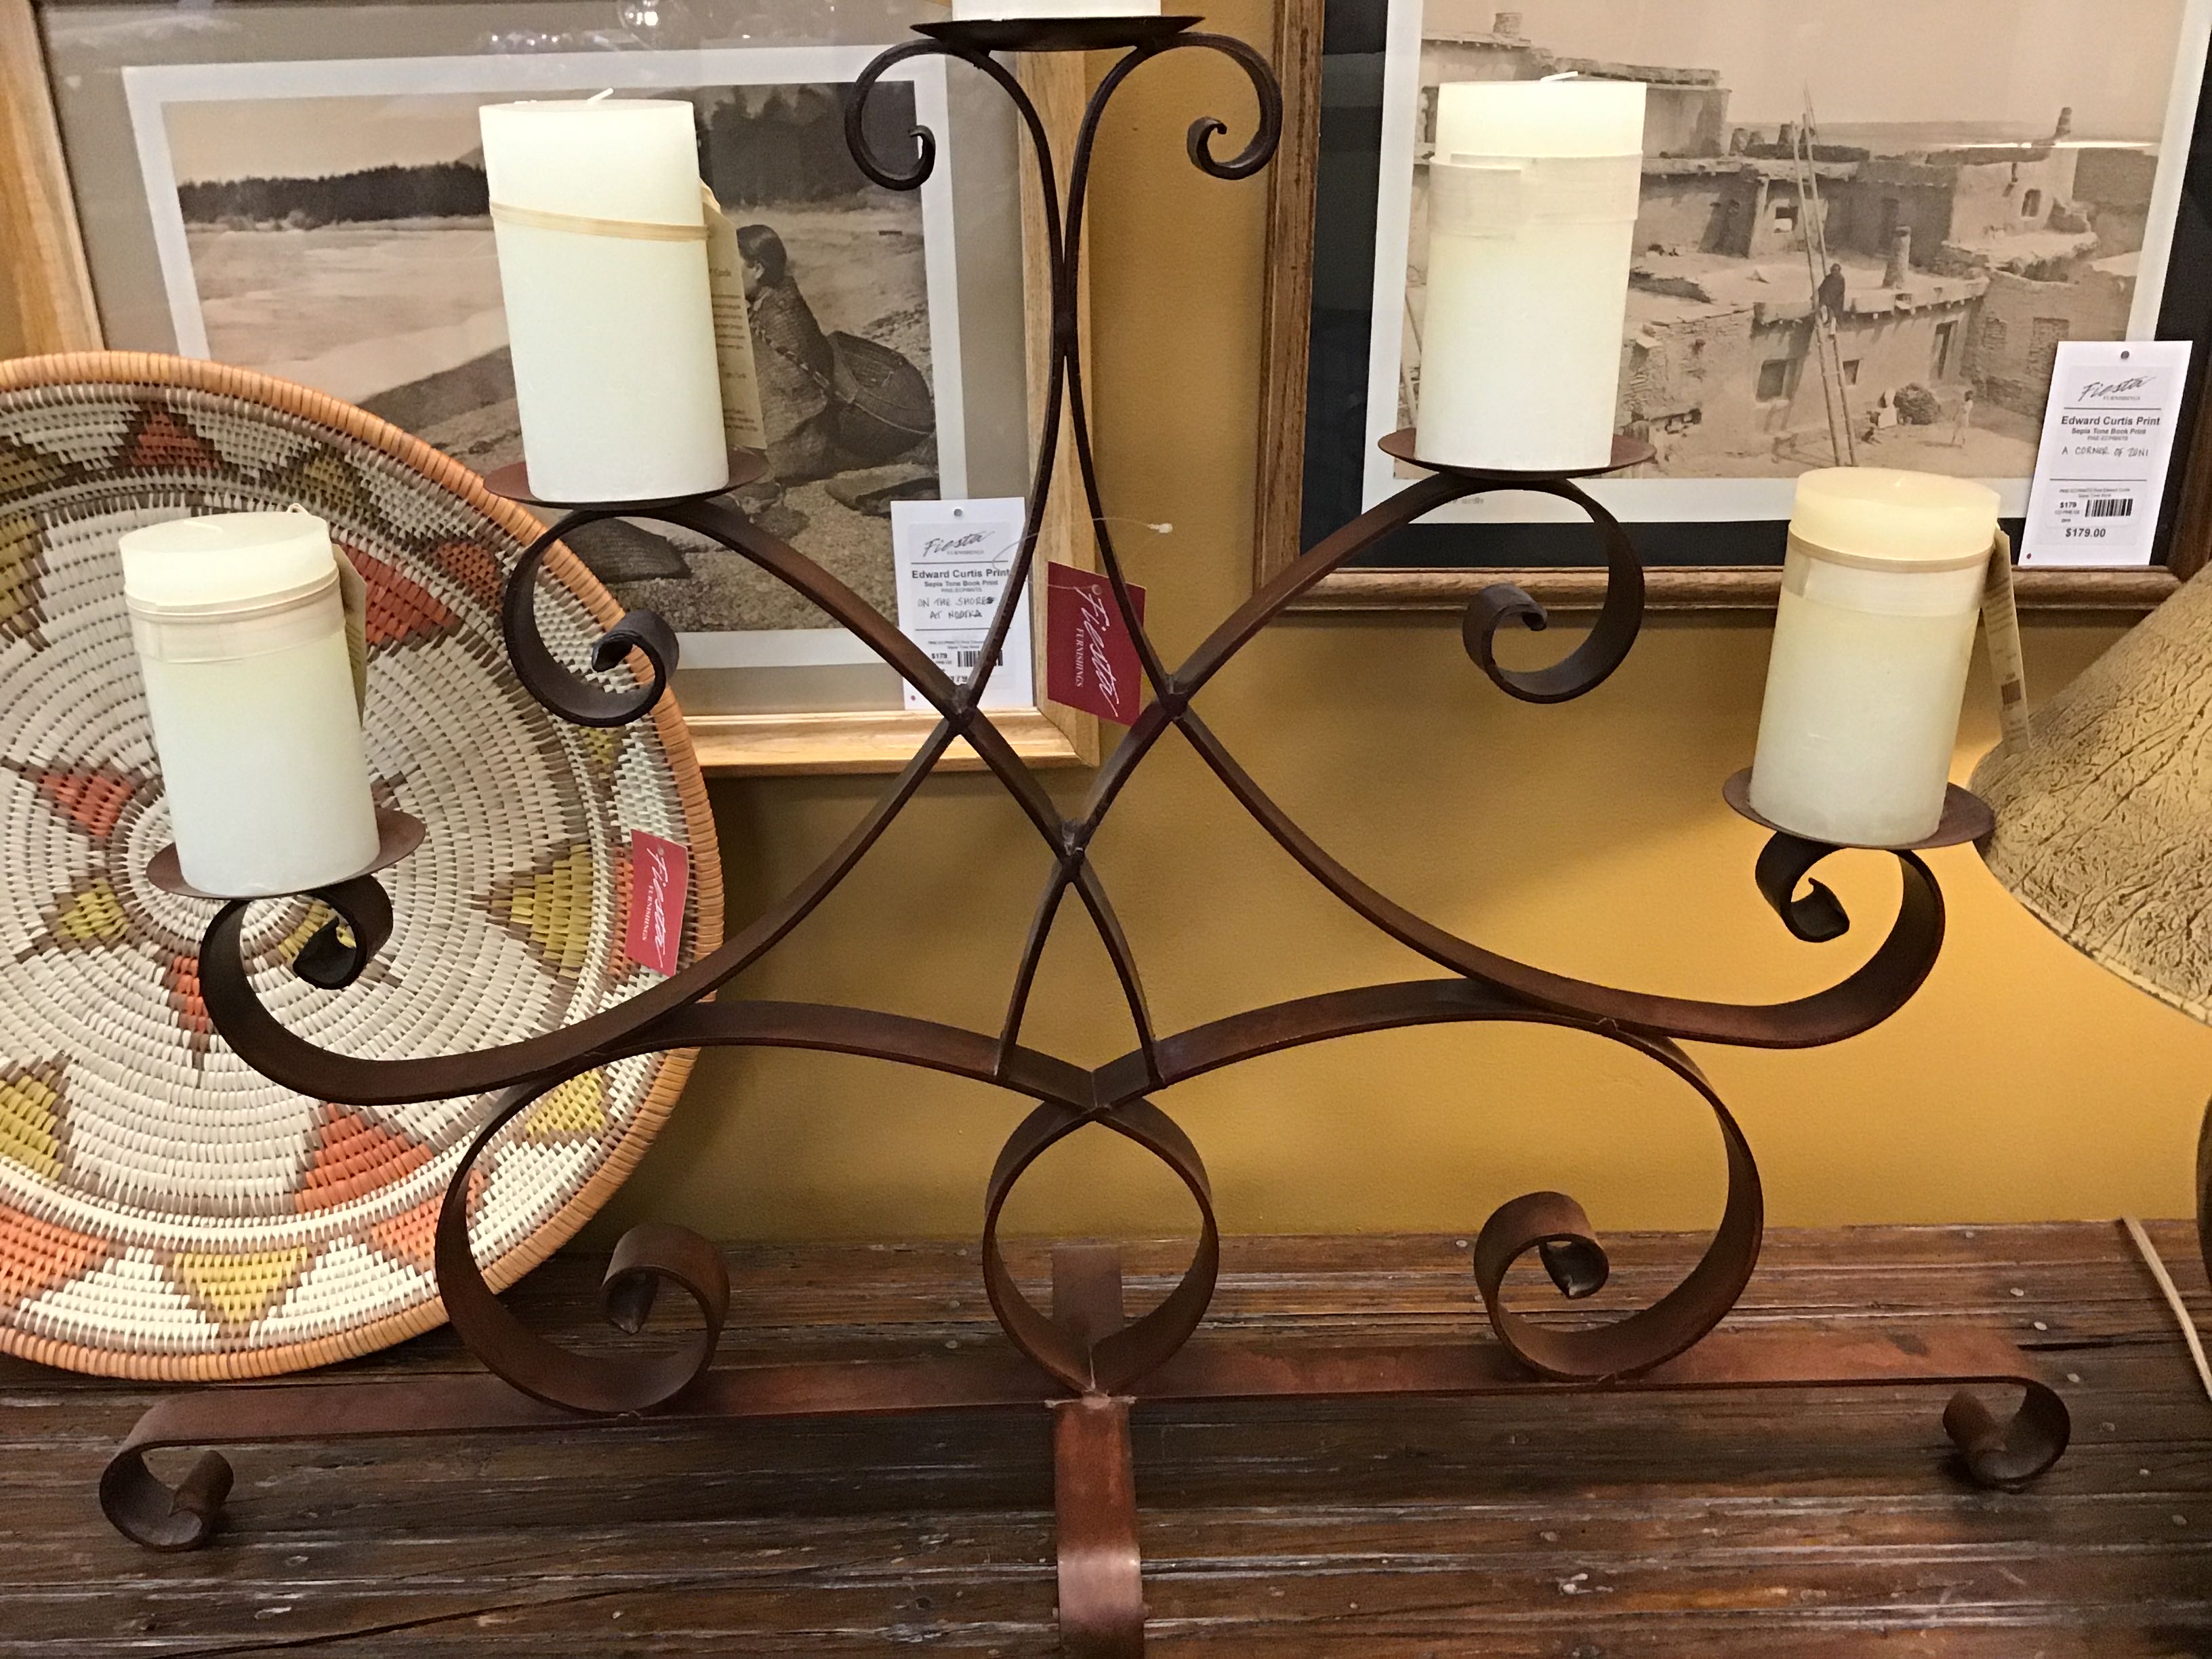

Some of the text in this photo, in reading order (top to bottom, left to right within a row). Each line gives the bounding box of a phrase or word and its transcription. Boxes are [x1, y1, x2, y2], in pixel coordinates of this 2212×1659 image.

[2078, 376, 2156, 402] Fiesta
[2061, 415, 2160, 426] Edward Curtis Print
[2062, 446, 2148, 457] A CORNER OF ZUNI
[2066, 528, 2106, 537] $179.00
[922, 531, 996, 557] Fiesta
[912, 569, 1010, 579] Edward Curtis Print
[918, 597, 929, 607] ON
[933, 598, 952, 607] THE
[930, 611, 943, 619] AT
[1073, 586, 1120, 717] Fiesta
[1076, 628, 1084, 687] FURNISHINGS
[642, 885, 653, 941] FURNISHINGS
[646, 848, 668, 968] Fiesta
